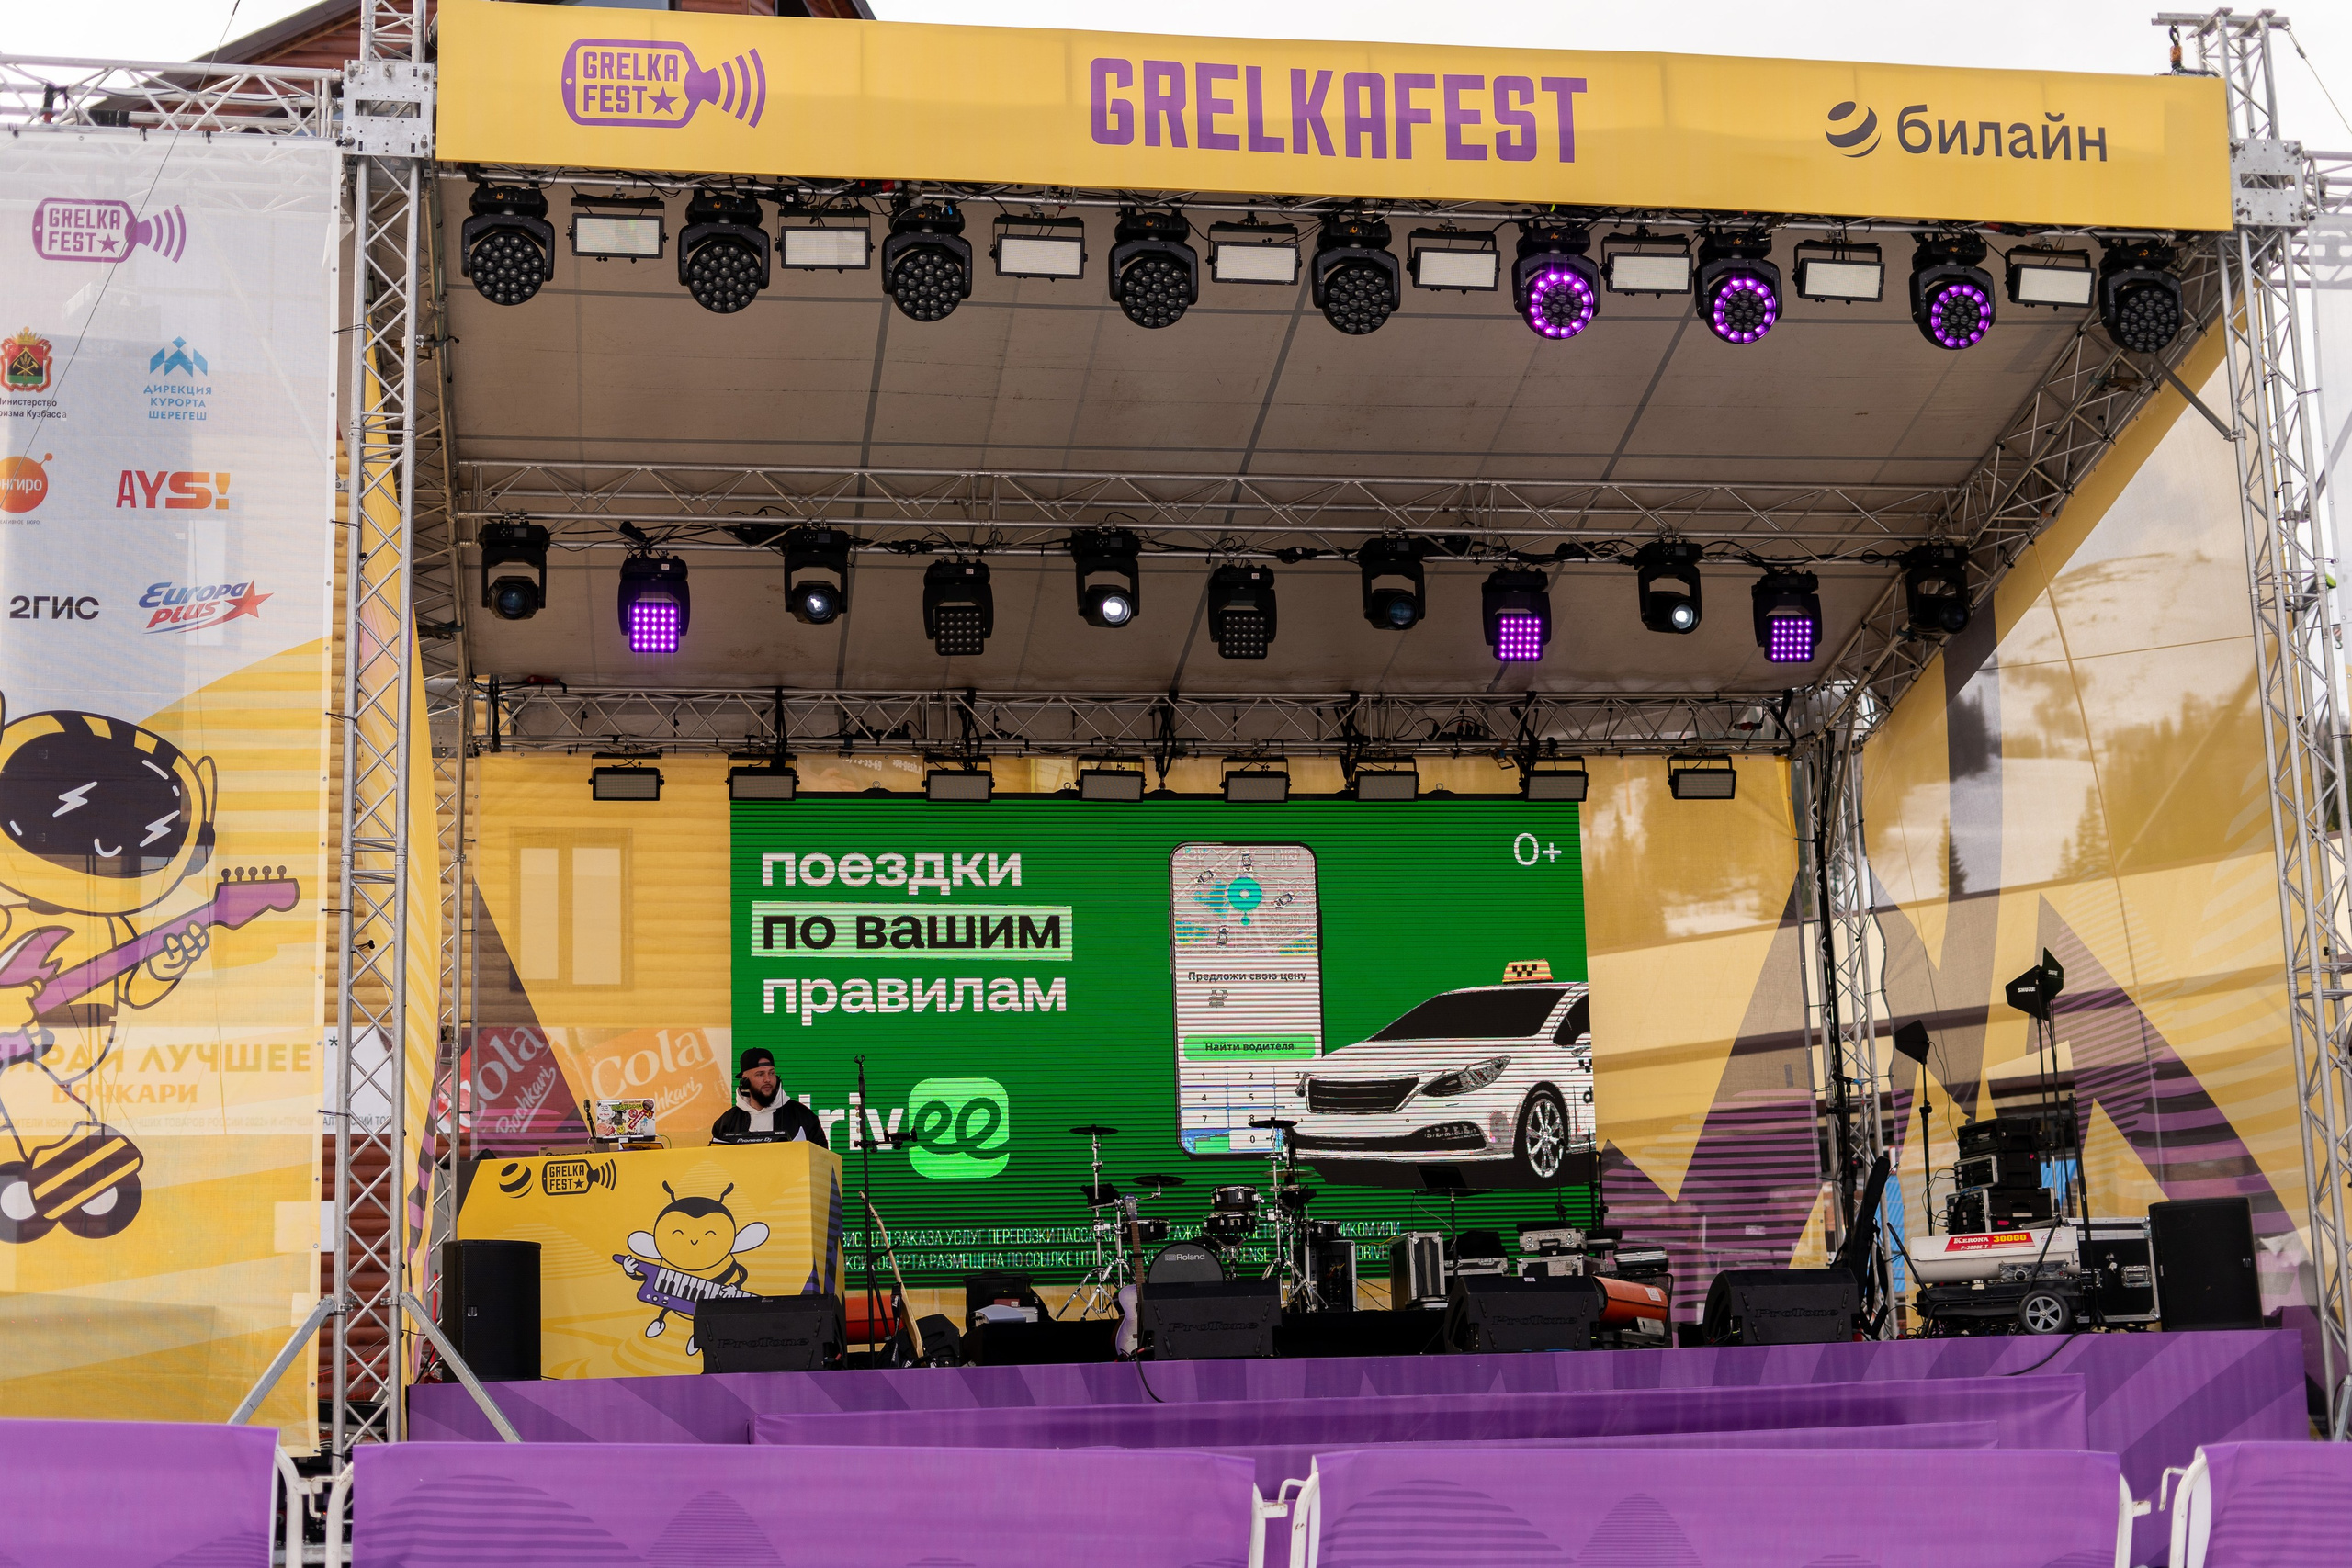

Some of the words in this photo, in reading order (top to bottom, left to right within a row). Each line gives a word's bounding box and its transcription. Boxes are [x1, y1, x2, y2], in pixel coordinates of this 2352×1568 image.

[582, 51, 679, 83] GRELKA
[582, 85, 648, 114] FEST
[1090, 57, 1588, 164] GRELKAFEST
[1896, 103, 2109, 162] билайн
[48, 207, 121, 231] GRELKA
[48, 231, 97, 253] FEST
[143, 384, 213, 397] ДИРЕКЦИЯ
[150, 397, 207, 408] КУРОРТА
[27, 409, 67, 419] Кузбасса
[148, 411, 208, 421] ШЕРЕГЕШ
[0, 479, 43, 494] нгиро
[116, 469, 231, 510] AYS!
[138, 581, 248, 608] Europa
[9, 595, 100, 620] 2ГИС
[1513, 832, 1563, 866] 0+
[762, 852, 1022, 896] поездки
[763, 914, 836, 950] по
[856, 914, 1061, 950] вашим
[1188, 971, 1247, 983] Предложи
[1250, 973, 1277, 982] свою
[1280, 973, 1307, 984] цену
[763, 976, 1067, 1027] правилам
[0, 1035, 124, 1073] ИРАЙ
[138, 1043, 311, 1073] ЛУЧШЕЕ
[1204, 1040, 1240, 1053] Найти
[1243, 1042, 1295, 1053] водителя
[591, 1029, 705, 1100] Cola
[1248, 1071, 1254, 1080] 2
[51, 1083, 198, 1104] БОЧКАРИ
[1201, 1093, 1207, 1102] 4
[1249, 1093, 1254, 1102] 5
[548, 1165, 585, 1179] GRELKA
[549, 1178, 574, 1190] FEST
[1953, 1236, 1990, 1245] KERONA
[1993, 1234, 2028, 1244] 30000
[1176, 1252, 1205, 1261] Roland
